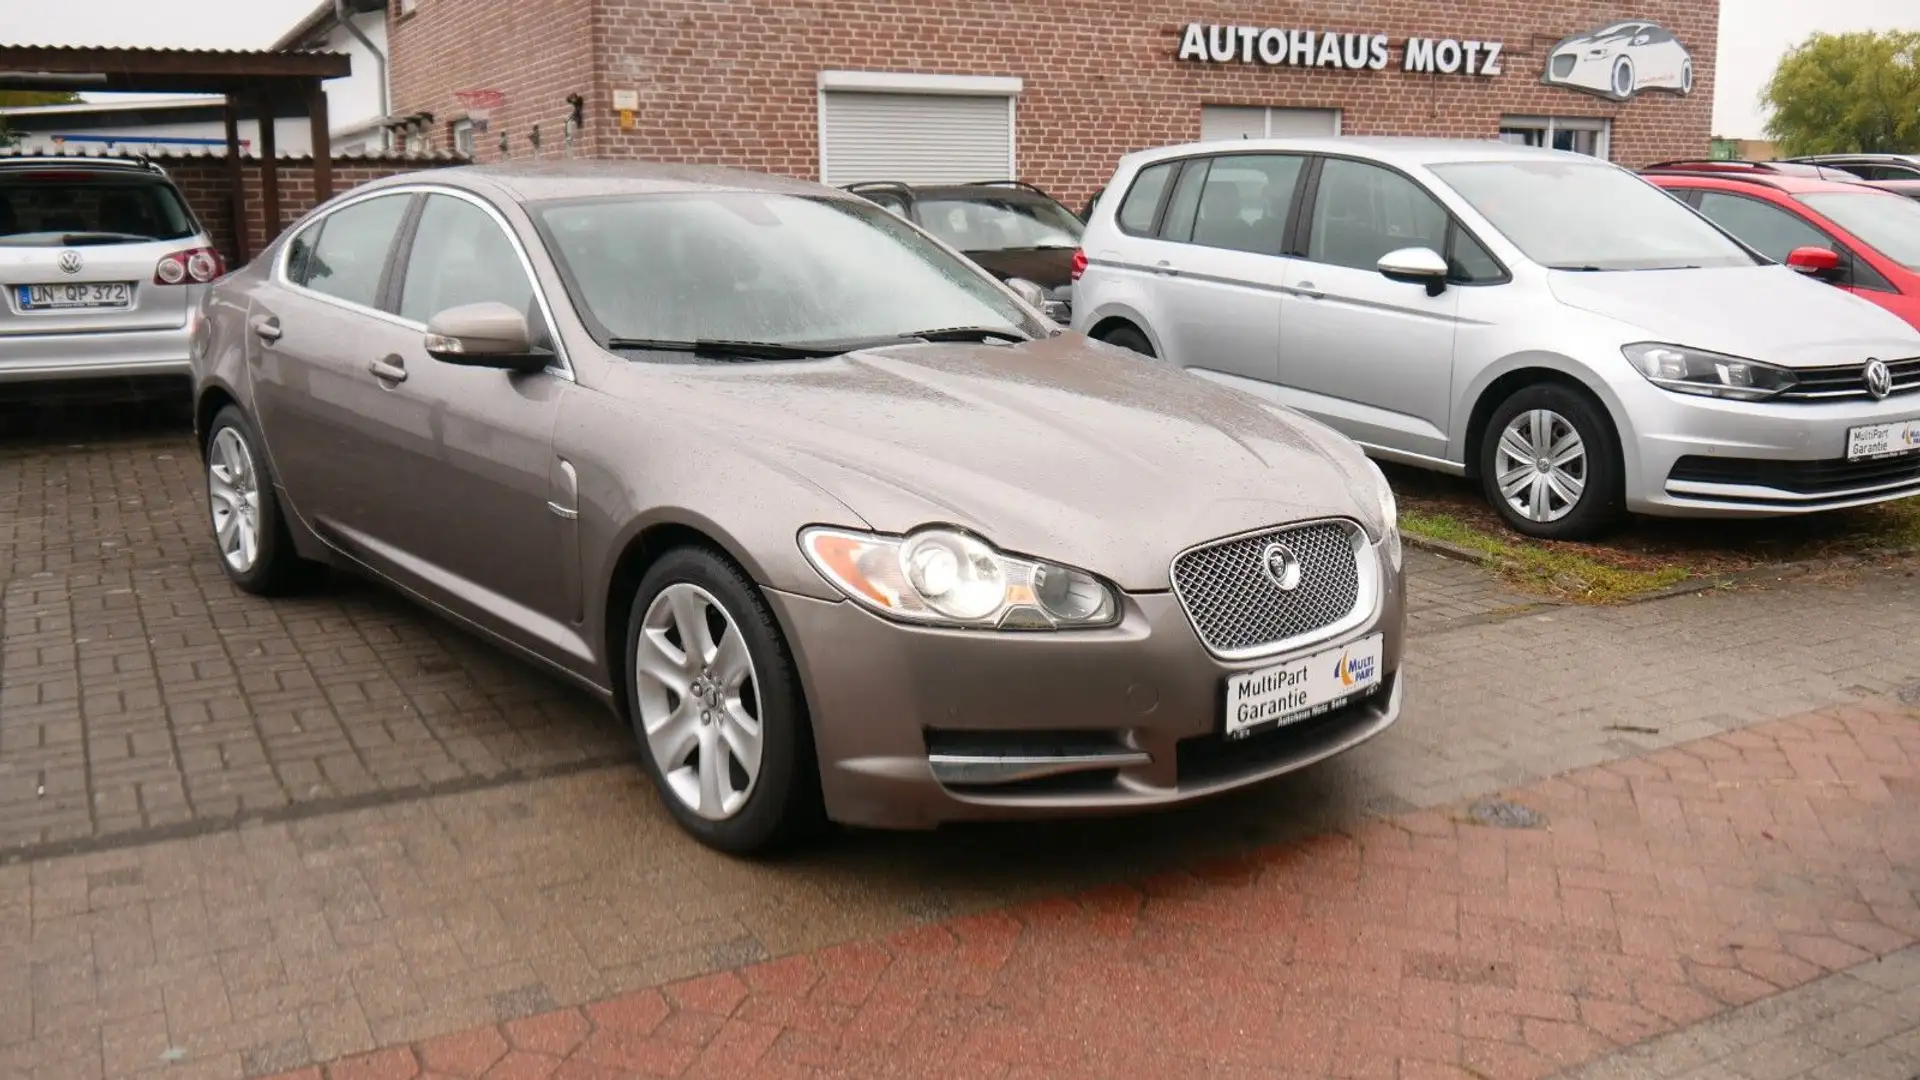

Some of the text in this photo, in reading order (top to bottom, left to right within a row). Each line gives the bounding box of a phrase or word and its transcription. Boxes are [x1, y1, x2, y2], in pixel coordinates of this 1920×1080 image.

[1178, 23, 1504, 75] AUTOHAUS MOTZ
[31, 284, 125, 302] UN QP 372
[1852, 441, 1888, 455] Garantie
[1238, 664, 1308, 700] MultiPart
[1236, 690, 1308, 723] Garantie
